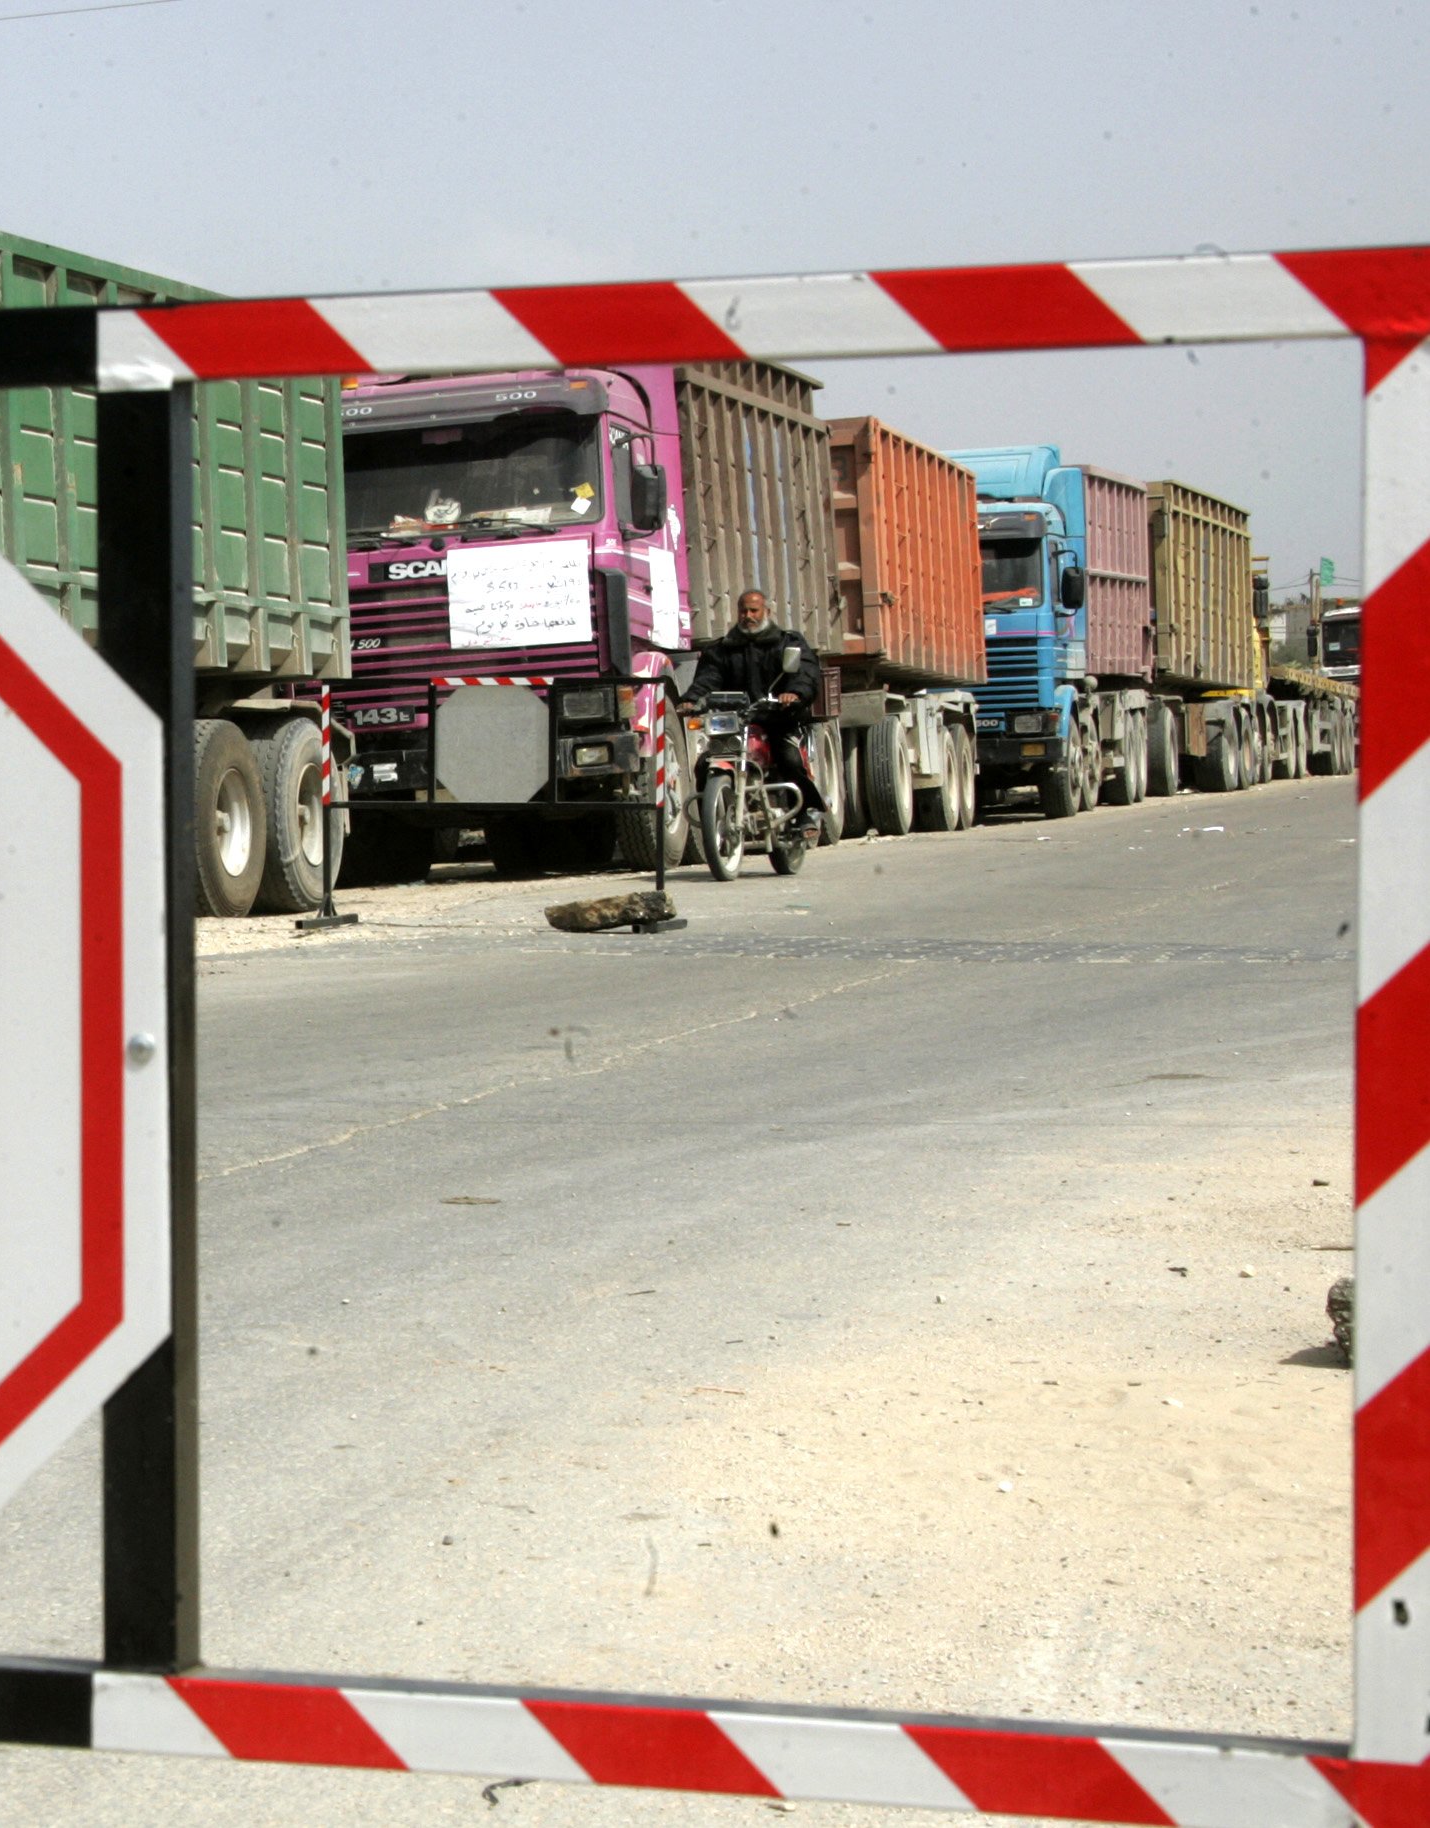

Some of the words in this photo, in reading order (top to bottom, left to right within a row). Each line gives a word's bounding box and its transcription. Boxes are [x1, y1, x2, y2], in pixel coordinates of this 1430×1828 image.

[495, 390, 537, 402] 500
[341, 406, 373, 417] 00
[357, 638, 381, 649] 500
